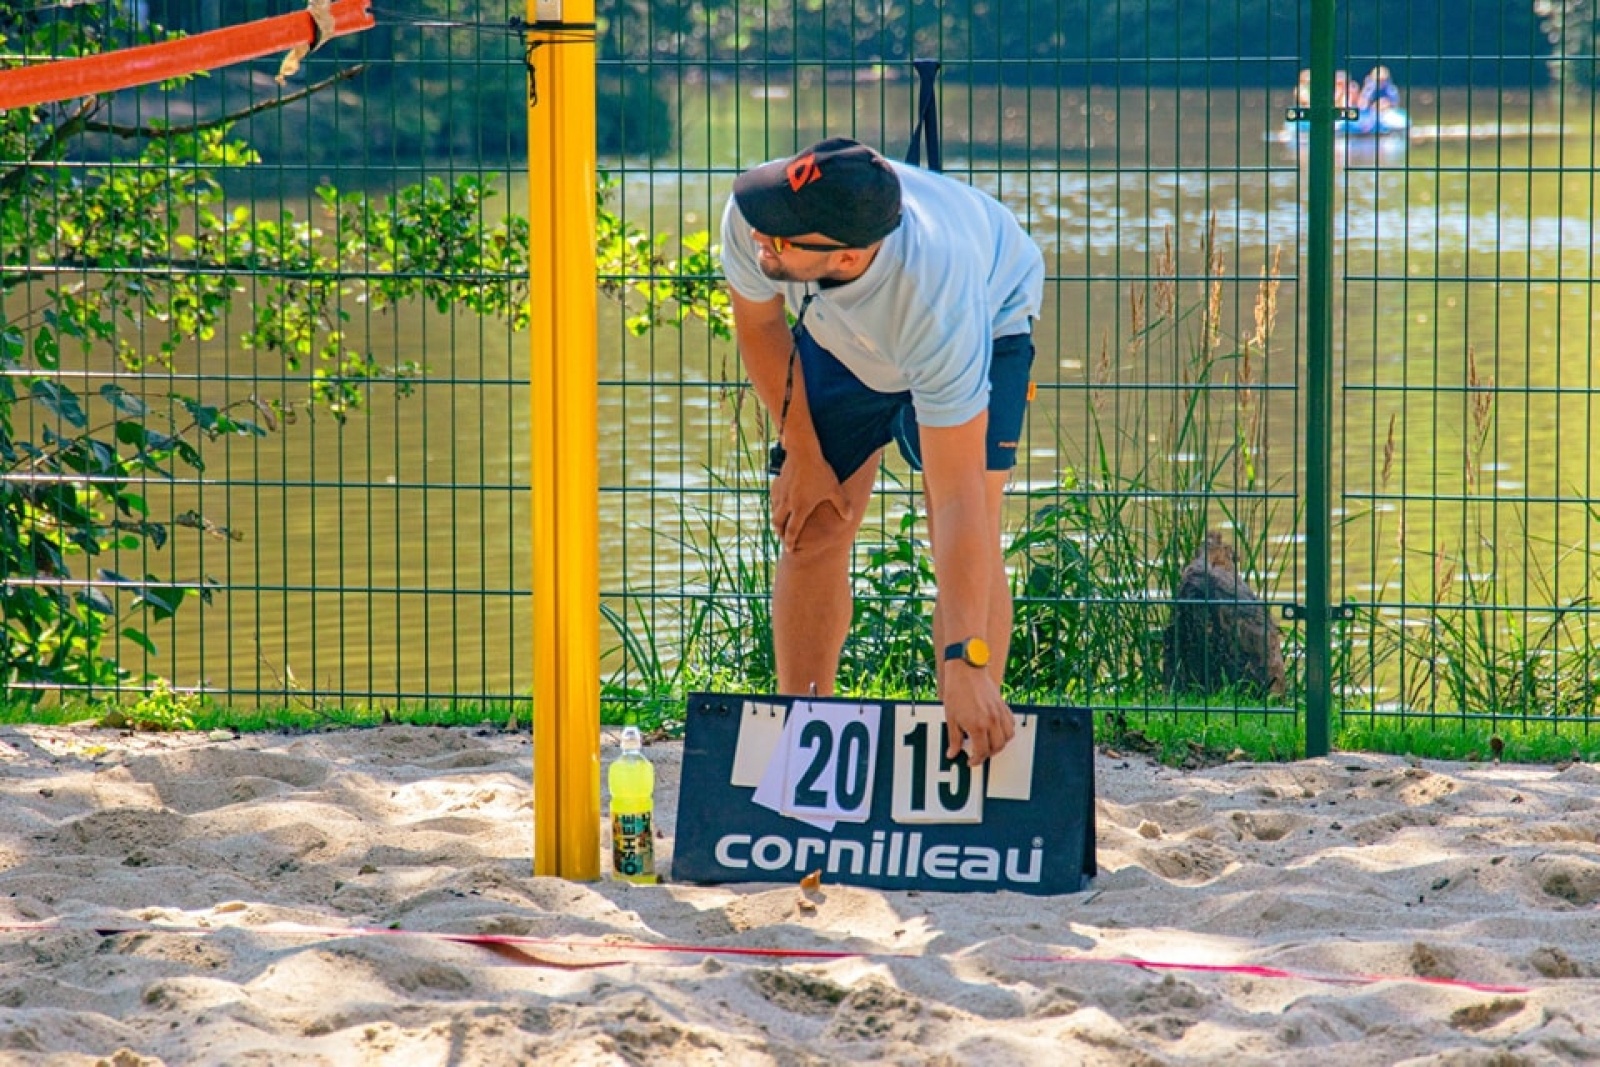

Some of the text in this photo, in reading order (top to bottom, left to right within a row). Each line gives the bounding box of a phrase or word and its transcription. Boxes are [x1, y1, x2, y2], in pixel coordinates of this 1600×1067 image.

[794, 719, 871, 811] 20
[902, 721, 971, 812] 15
[715, 830, 1043, 883] cornilleau
